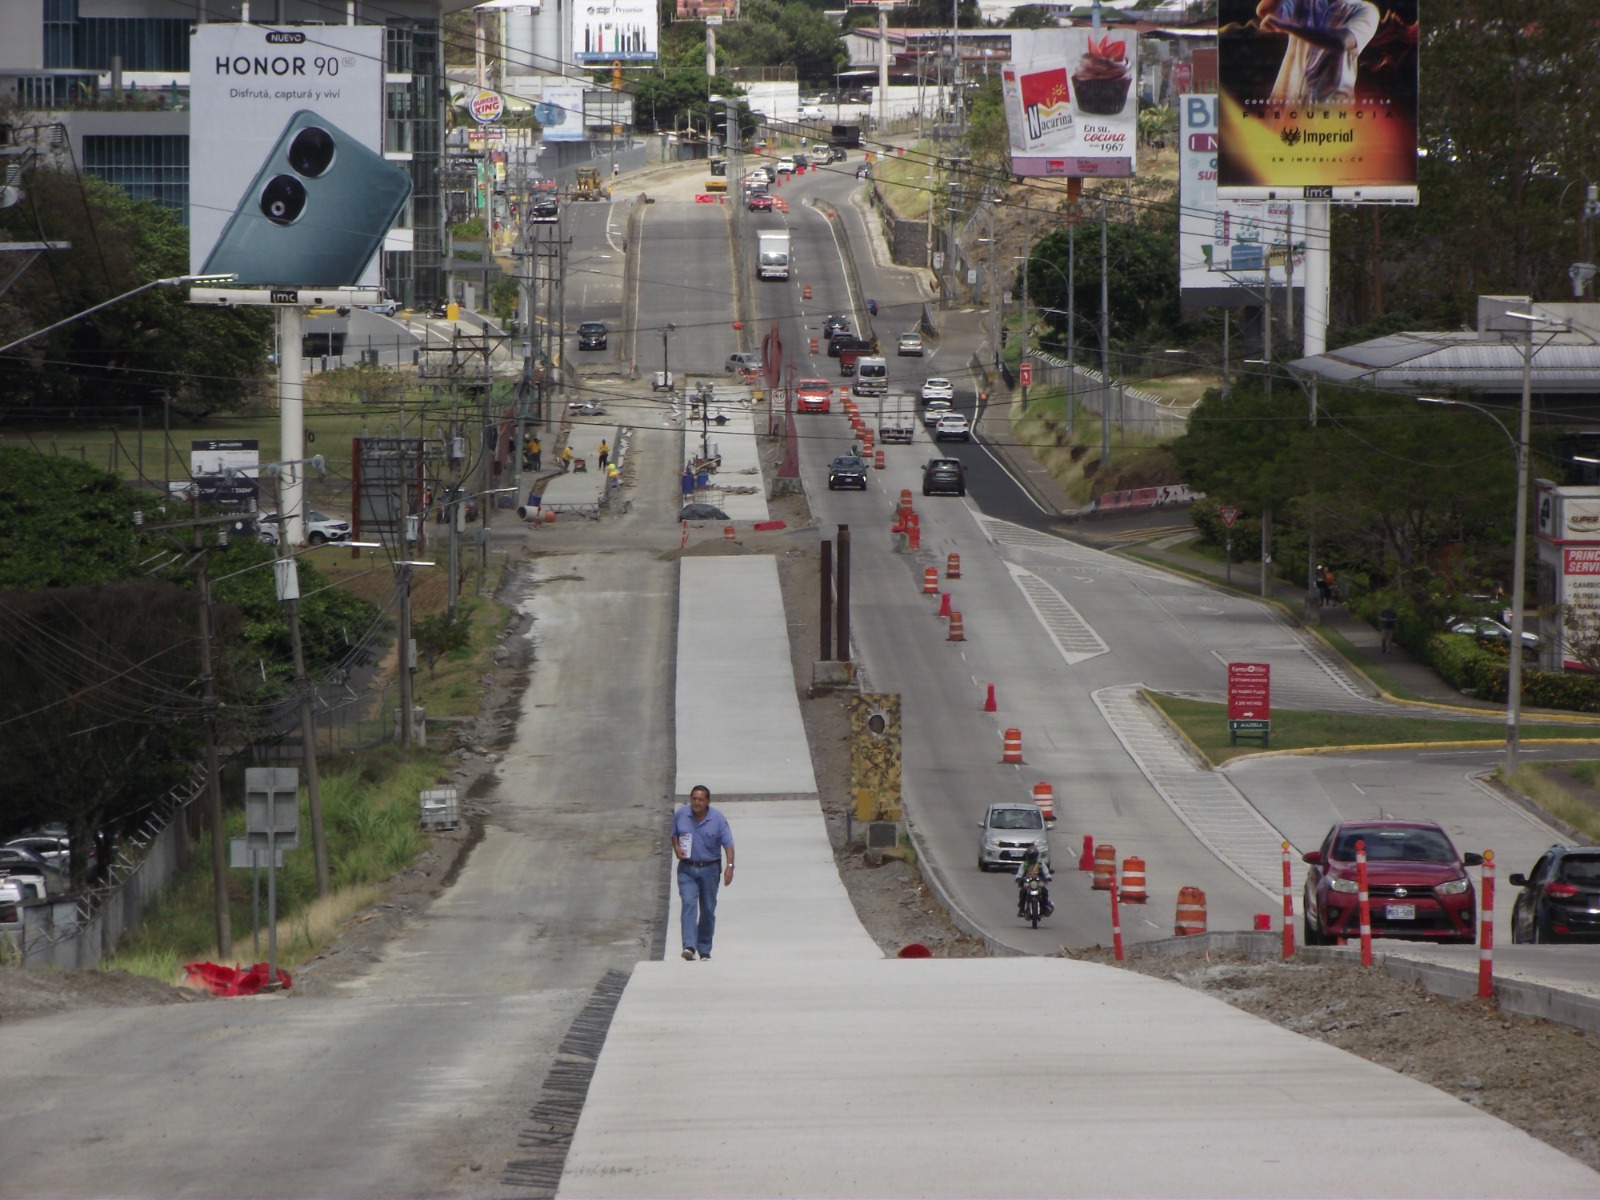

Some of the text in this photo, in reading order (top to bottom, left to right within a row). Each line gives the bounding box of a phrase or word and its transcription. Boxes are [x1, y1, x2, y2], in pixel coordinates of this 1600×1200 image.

[271, 34, 302, 42] NUEVO
[216, 56, 306, 75] HONOR
[314, 57, 339, 76] 90
[230, 88, 340, 101] Disfrutá, capturá y viví
[473, 96, 499, 107] BURGER
[475, 103, 500, 115] KING
[1243, 111, 1394, 119] FRECUENCIA
[1027, 103, 1073, 140] Nacarina
[1083, 124, 1096, 132] En
[1083, 131, 1127, 142] cocina
[1303, 129, 1354, 146] Imperial
[1100, 143, 1124, 152] 1967
[1305, 187, 1331, 198] imc
[272, 293, 296, 302] imc
[1570, 515, 1599, 523] SUPER
